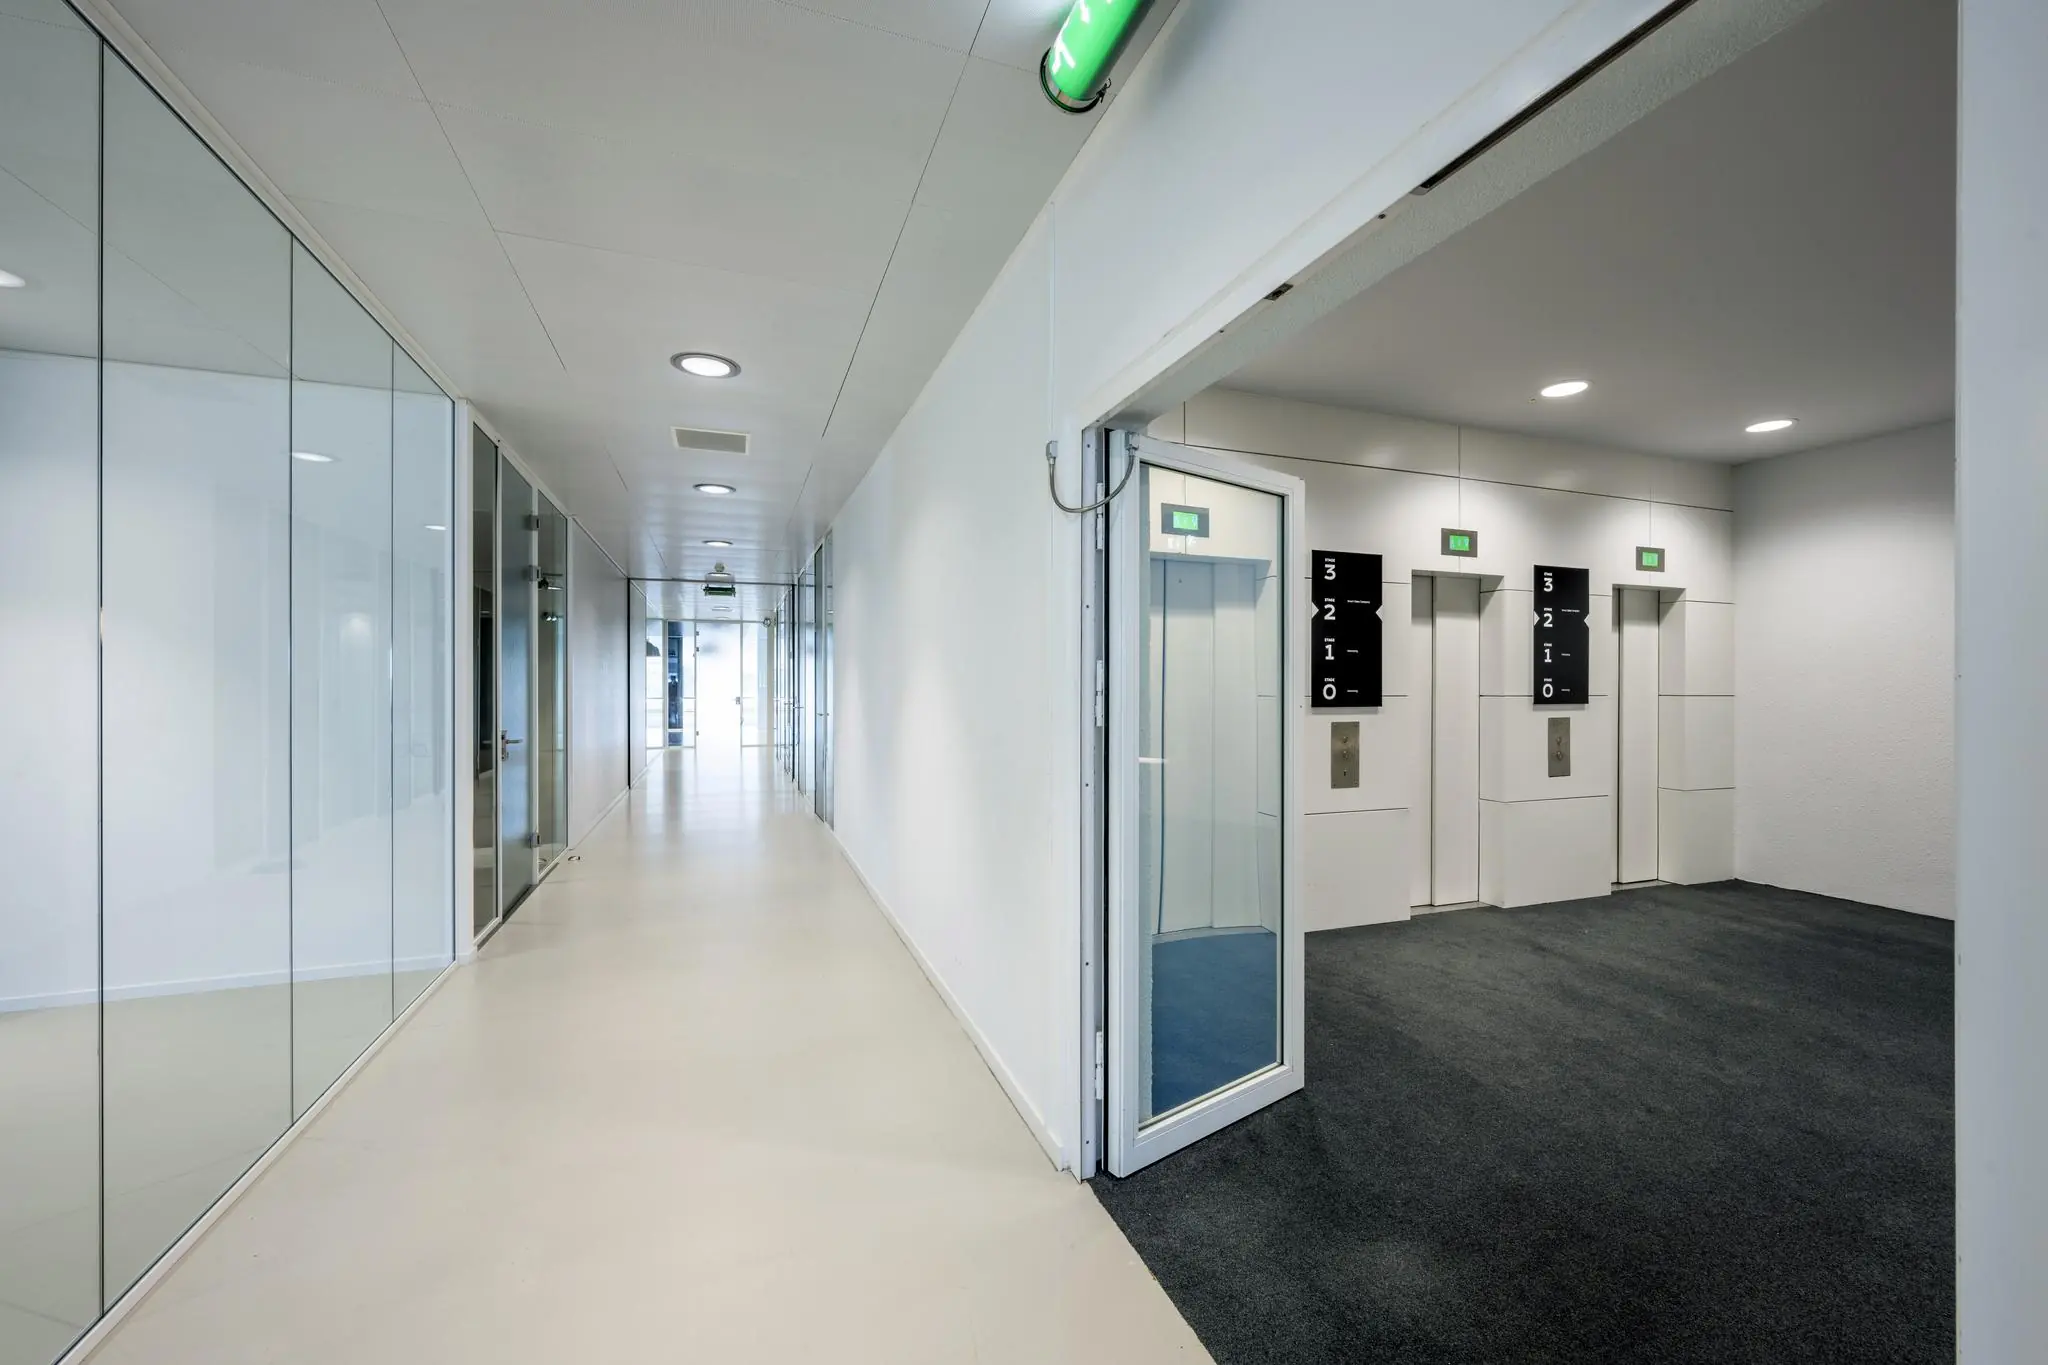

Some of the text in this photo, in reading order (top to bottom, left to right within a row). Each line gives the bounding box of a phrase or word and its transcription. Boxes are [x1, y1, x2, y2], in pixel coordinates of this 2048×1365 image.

[1324, 564, 1336, 580] 3
[1543, 577, 1553, 592] 3
[1324, 604, 1336, 620] 2
[1543, 612, 1553, 628] 2
[1324, 644, 1335, 660] 1
[1544, 648, 1552, 663] 1
[1322, 683, 1337, 700] 0
[1542, 683, 1553, 698] 0
